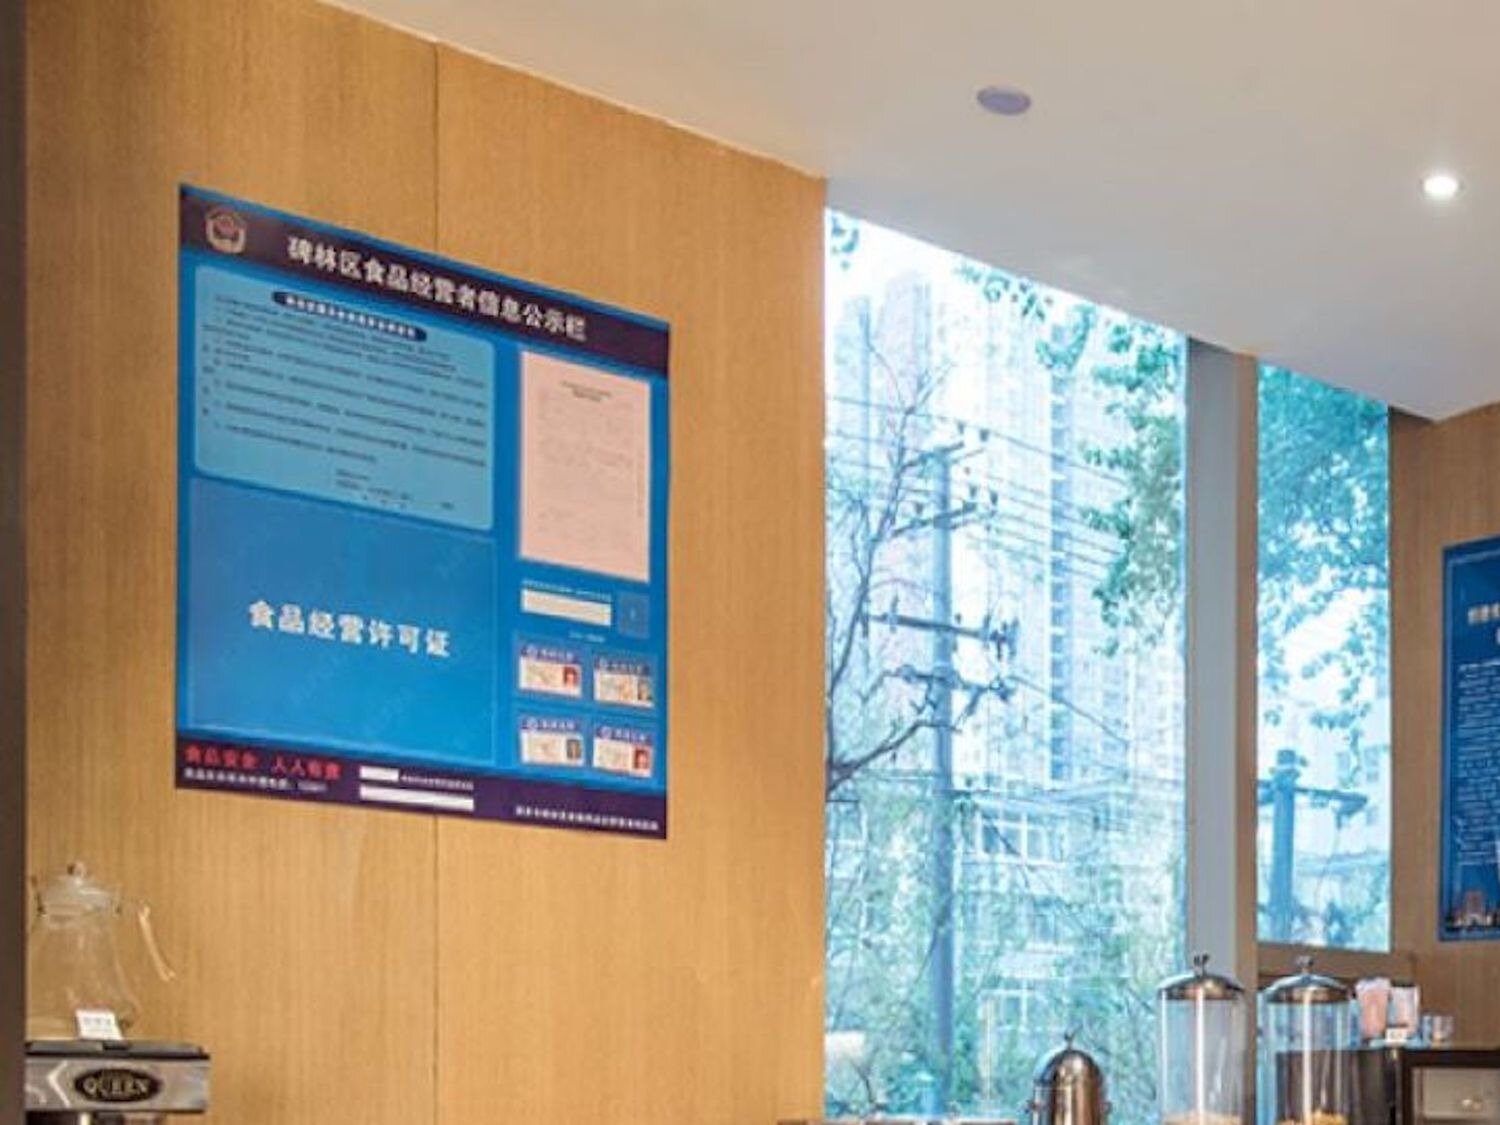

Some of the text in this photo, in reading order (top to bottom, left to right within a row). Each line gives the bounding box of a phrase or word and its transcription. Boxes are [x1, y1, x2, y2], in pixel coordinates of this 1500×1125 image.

[287, 236, 587, 341] 碑林区食品经营者信息公示栏
[248, 599, 451, 659] 食品经营许可证
[82, 1072, 150, 1097] QUEEN
